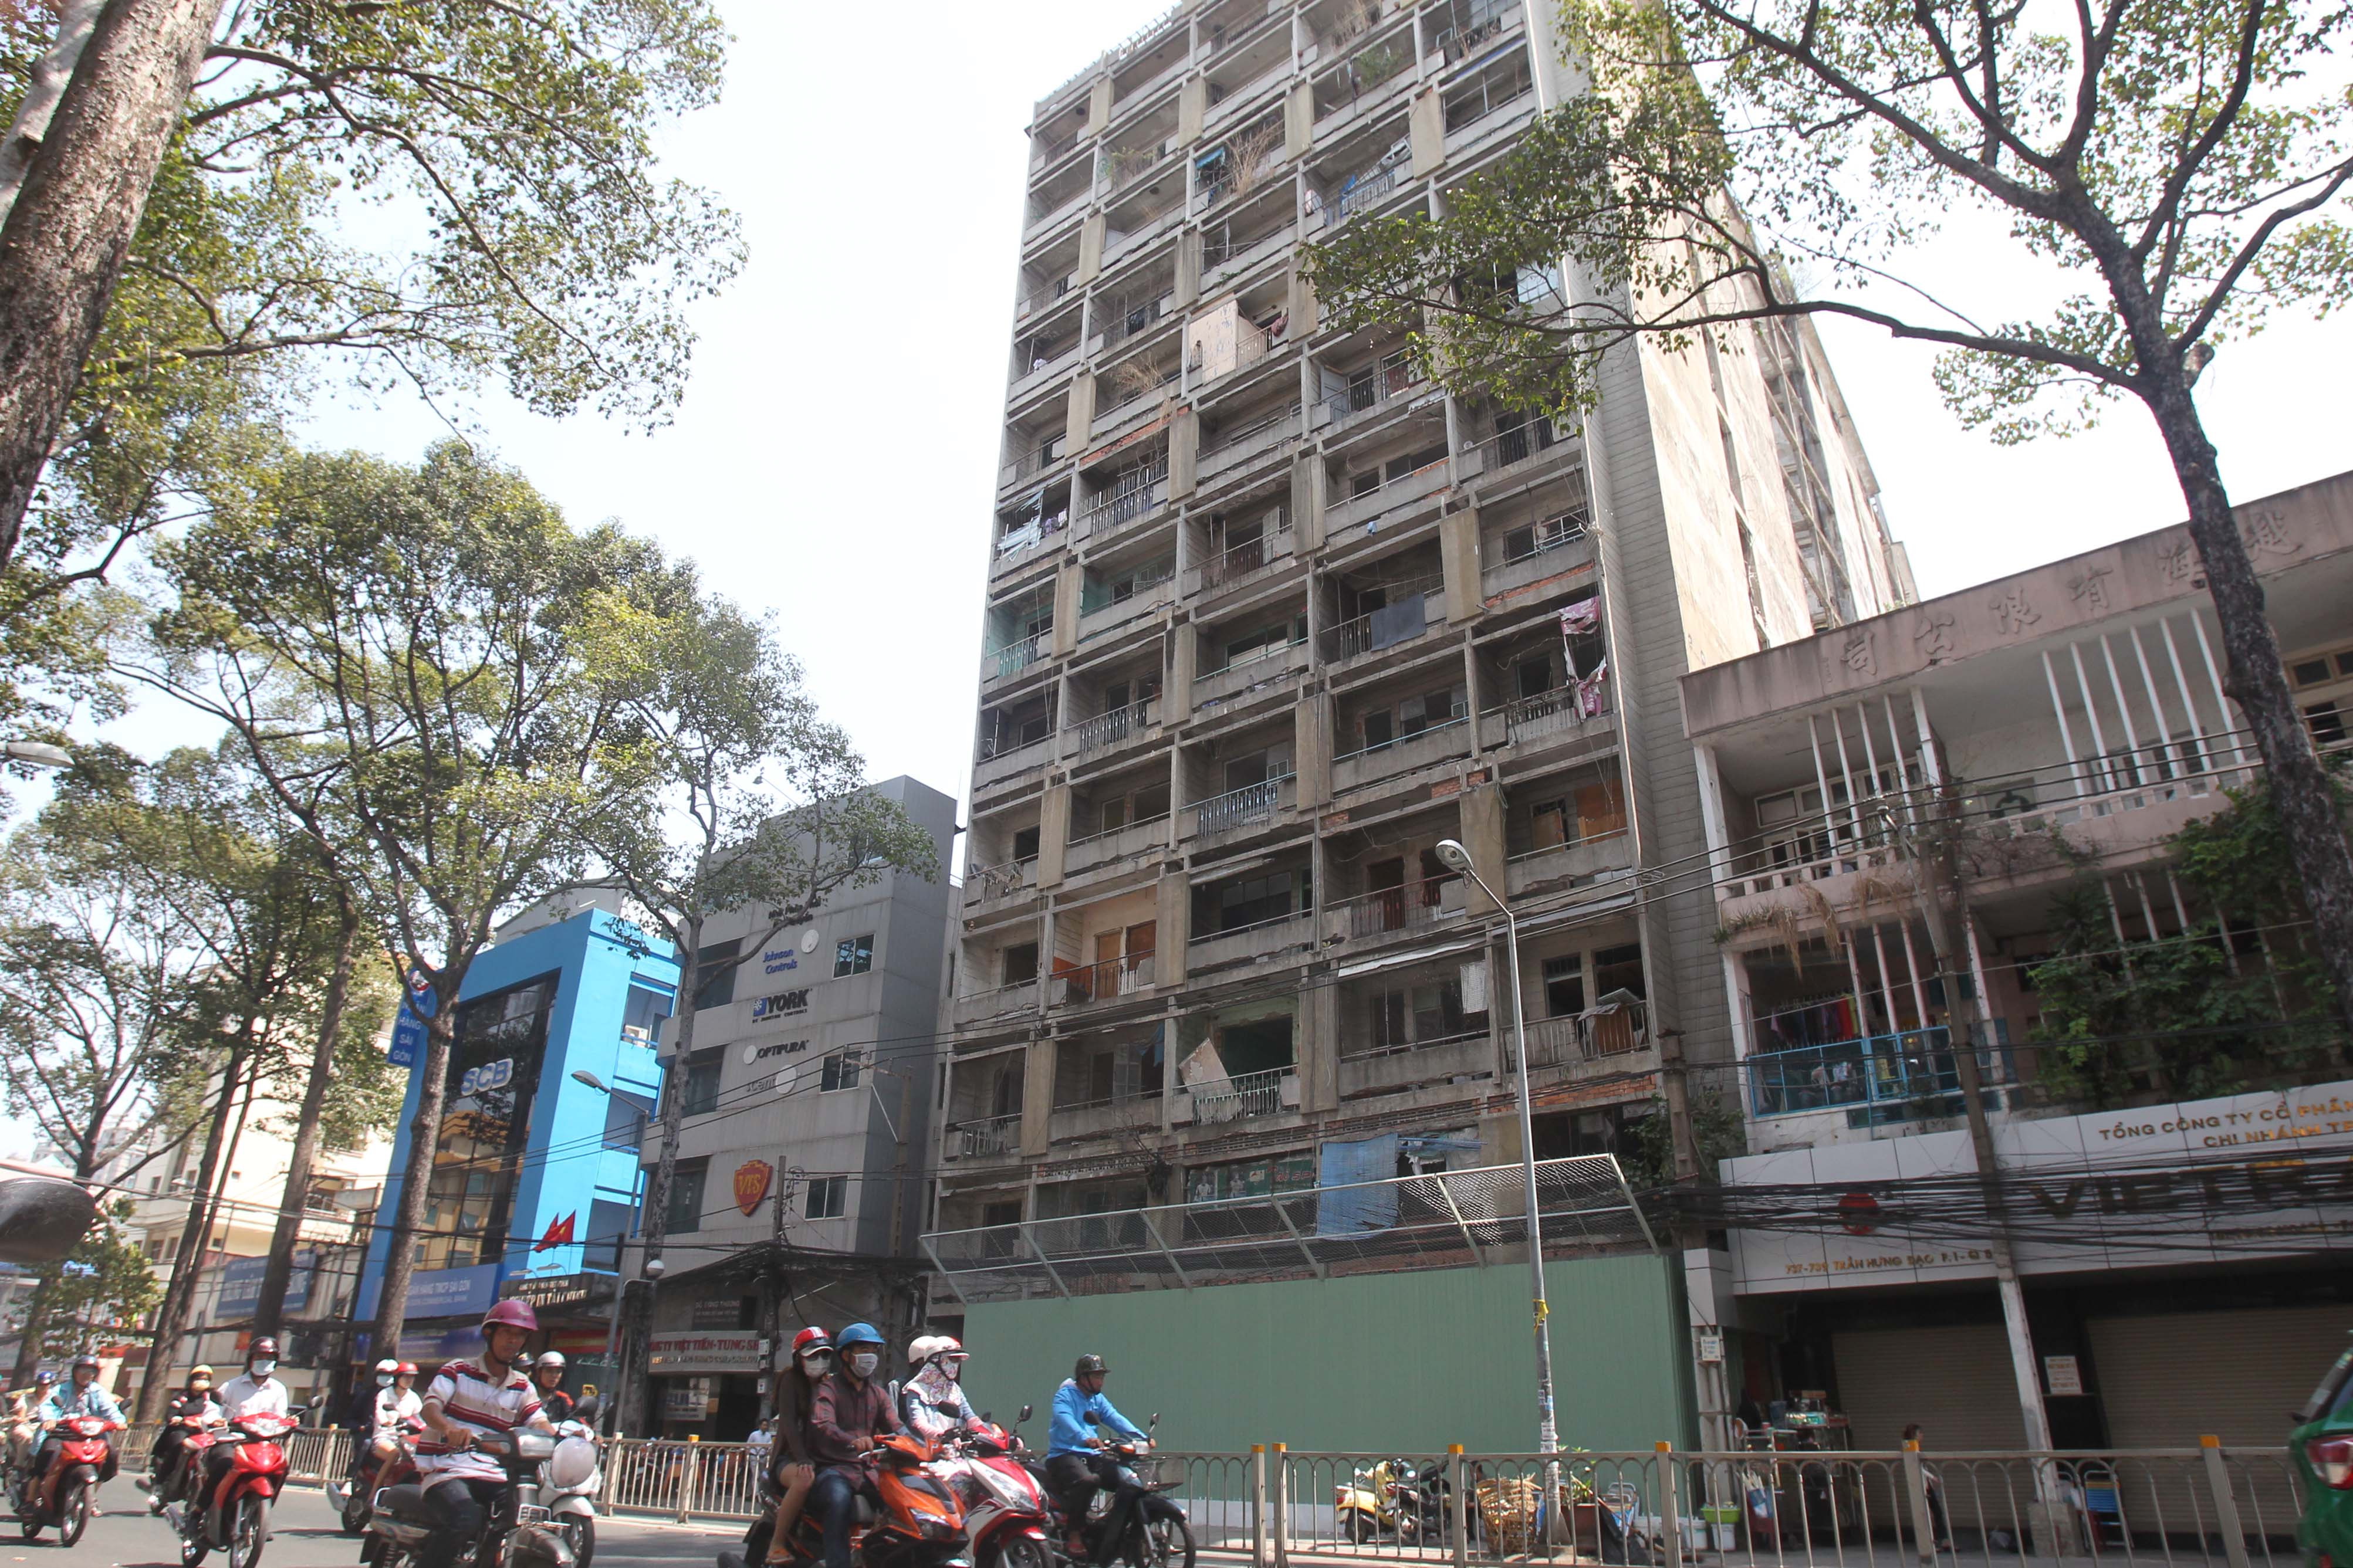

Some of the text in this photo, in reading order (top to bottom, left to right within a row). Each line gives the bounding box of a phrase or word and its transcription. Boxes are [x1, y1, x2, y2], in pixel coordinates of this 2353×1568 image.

[763, 949, 794, 963] Johnson
[765, 959, 797, 974] Controls
[766, 988, 809, 1014] YORK
[758, 1040, 806, 1059] OPTIPURA
[461, 1060, 512, 1094] SCB
[2099, 1122, 2155, 1140] TỔNG
[2162, 1116, 2220, 1133] CÔNG
[2225, 1112, 2253, 1125] TY
[2260, 1100, 2291, 1121] CỔ
[2203, 1133, 2239, 1147] CHI
[2245, 1124, 2322, 1143] NHÁNH
[739, 1174, 762, 1195] VTS
